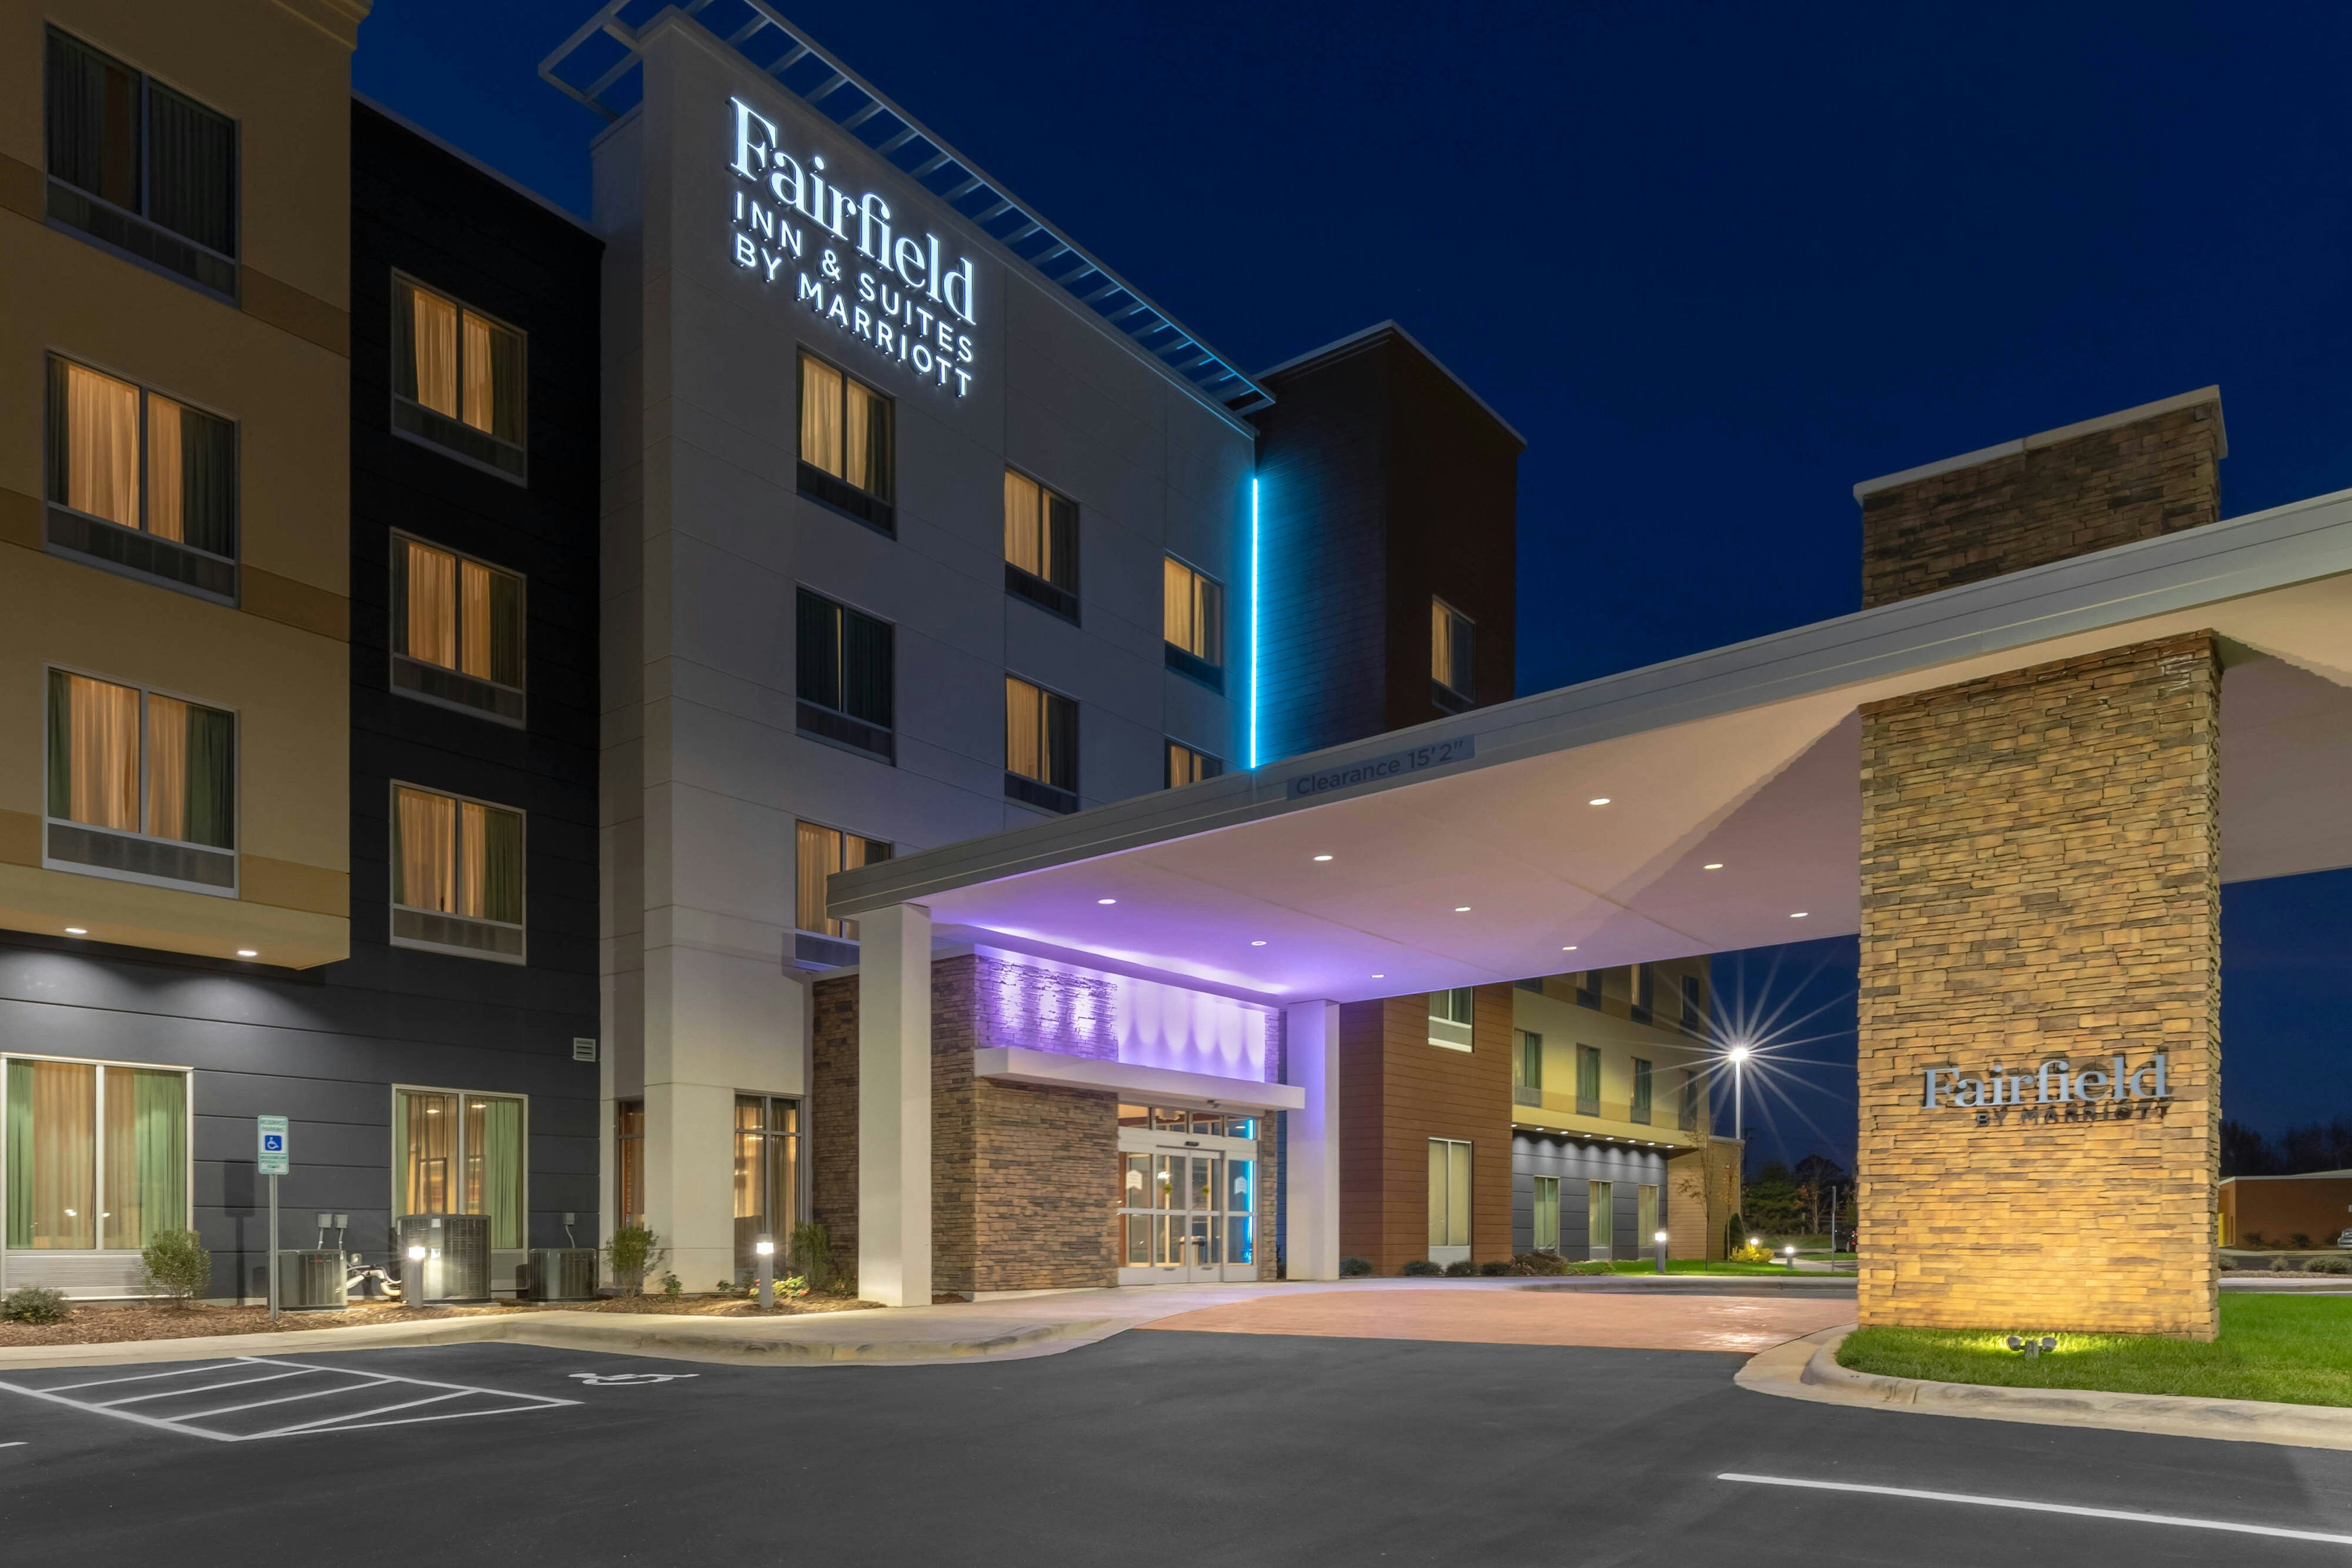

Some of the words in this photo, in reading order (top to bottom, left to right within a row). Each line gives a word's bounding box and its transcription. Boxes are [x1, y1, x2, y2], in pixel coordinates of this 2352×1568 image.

[730, 95, 977, 326] Fairfield
[734, 190, 803, 258] INN
[821, 248, 841, 282] &
[858, 272, 974, 363] SUITES
[736, 233, 782, 280] BY
[799, 272, 972, 397] MARRIOTT
[1296, 758, 1401, 794] Clearance
[1922, 1054, 2173, 1110] Fairfield
[1976, 1109, 2008, 1127] BY
[2021, 1102, 2171, 1125] MARRIOTT
